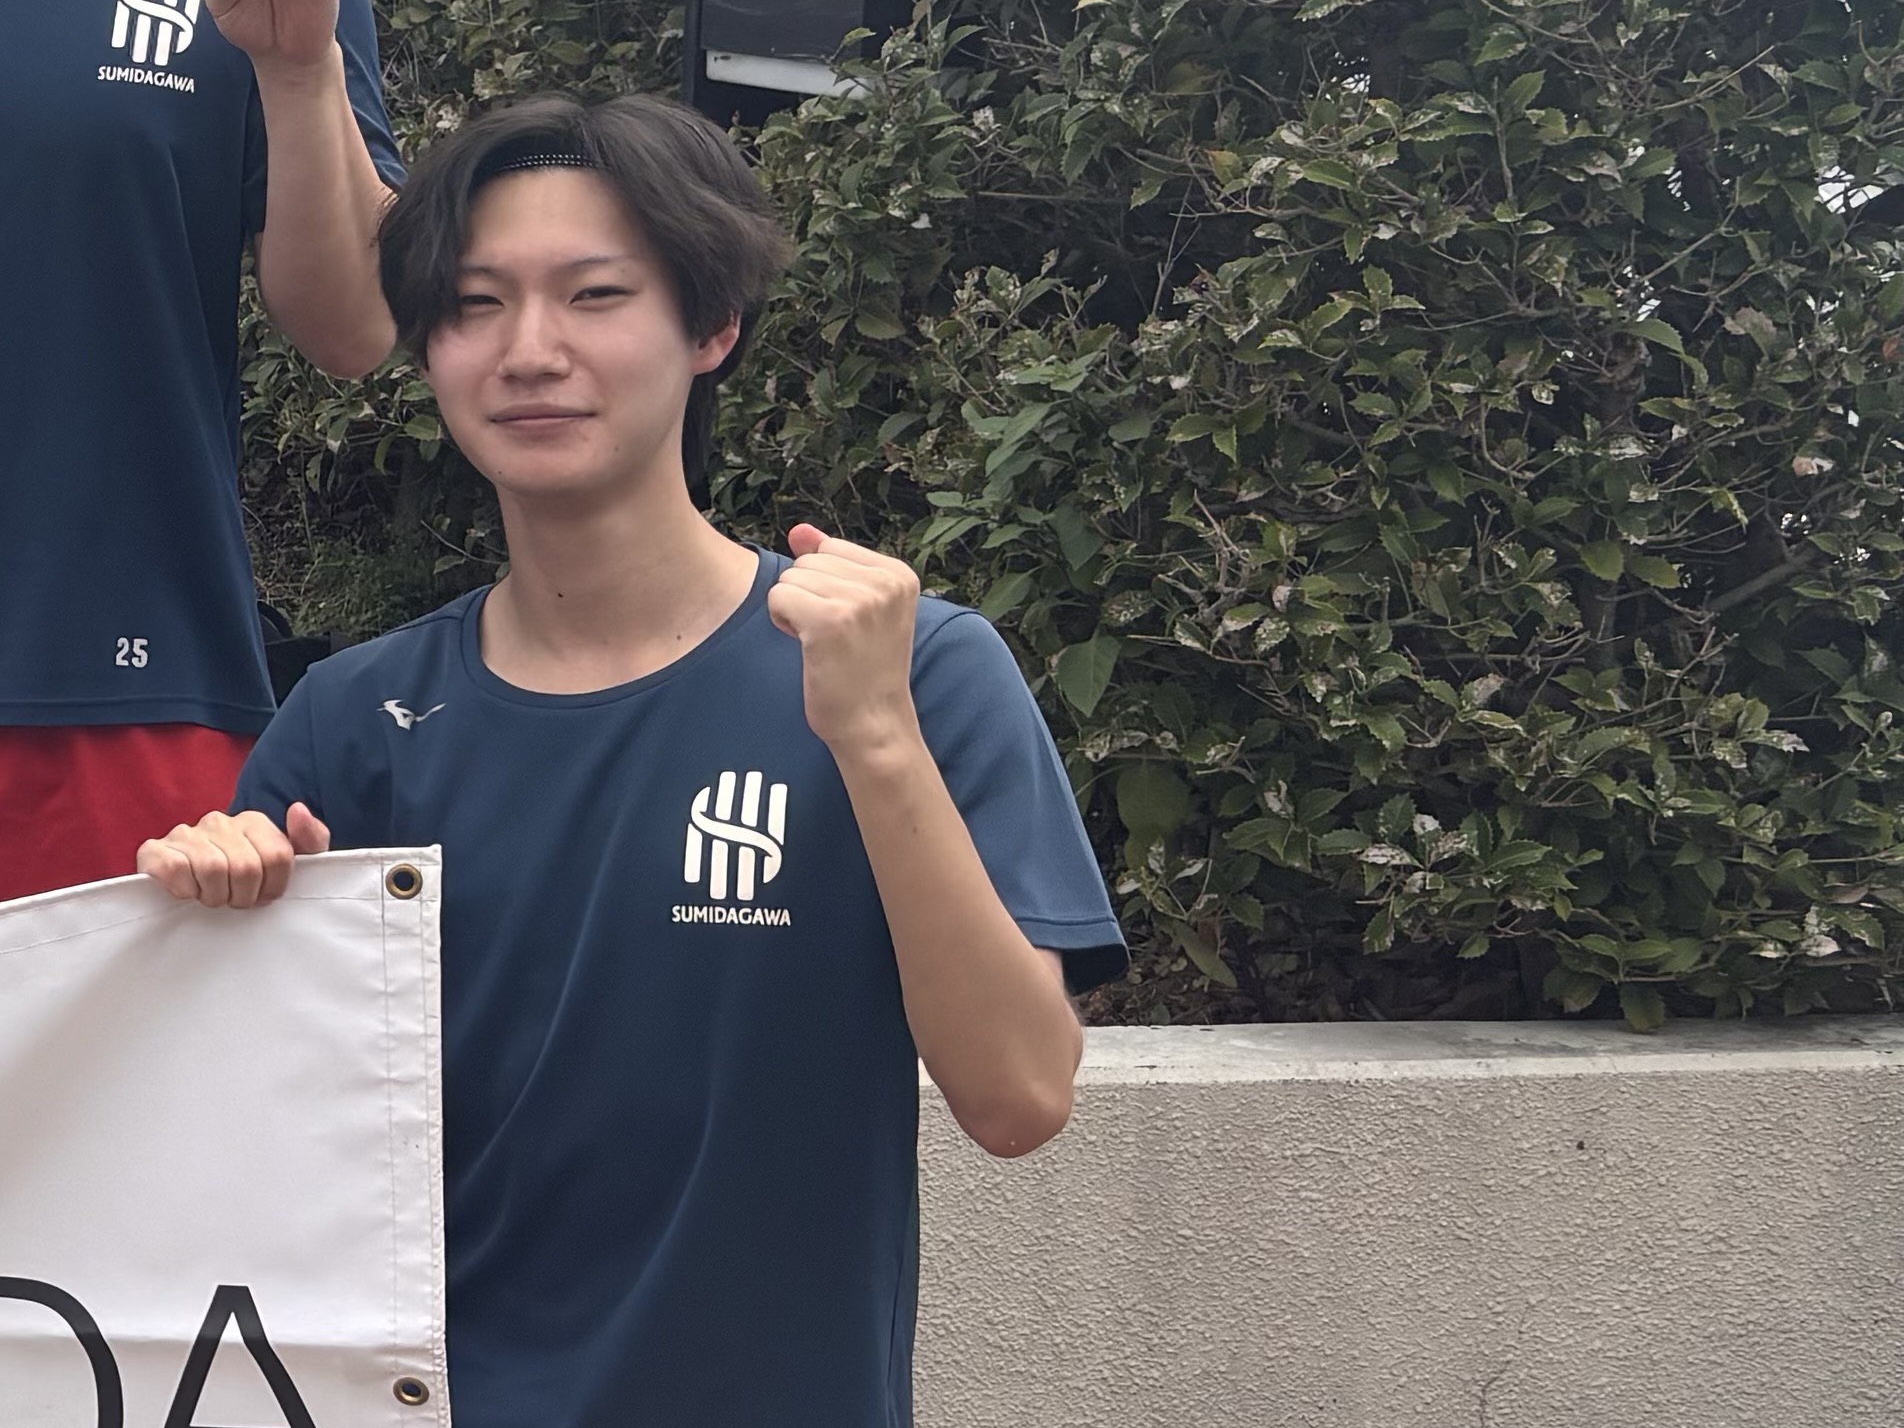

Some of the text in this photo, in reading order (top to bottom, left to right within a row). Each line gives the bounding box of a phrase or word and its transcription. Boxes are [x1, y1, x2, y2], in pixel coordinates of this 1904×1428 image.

[97, 66, 195, 93] SUMIDAGAWA
[115, 637, 148, 668] 25
[672, 905, 791, 926] SUMIDAGAWA
